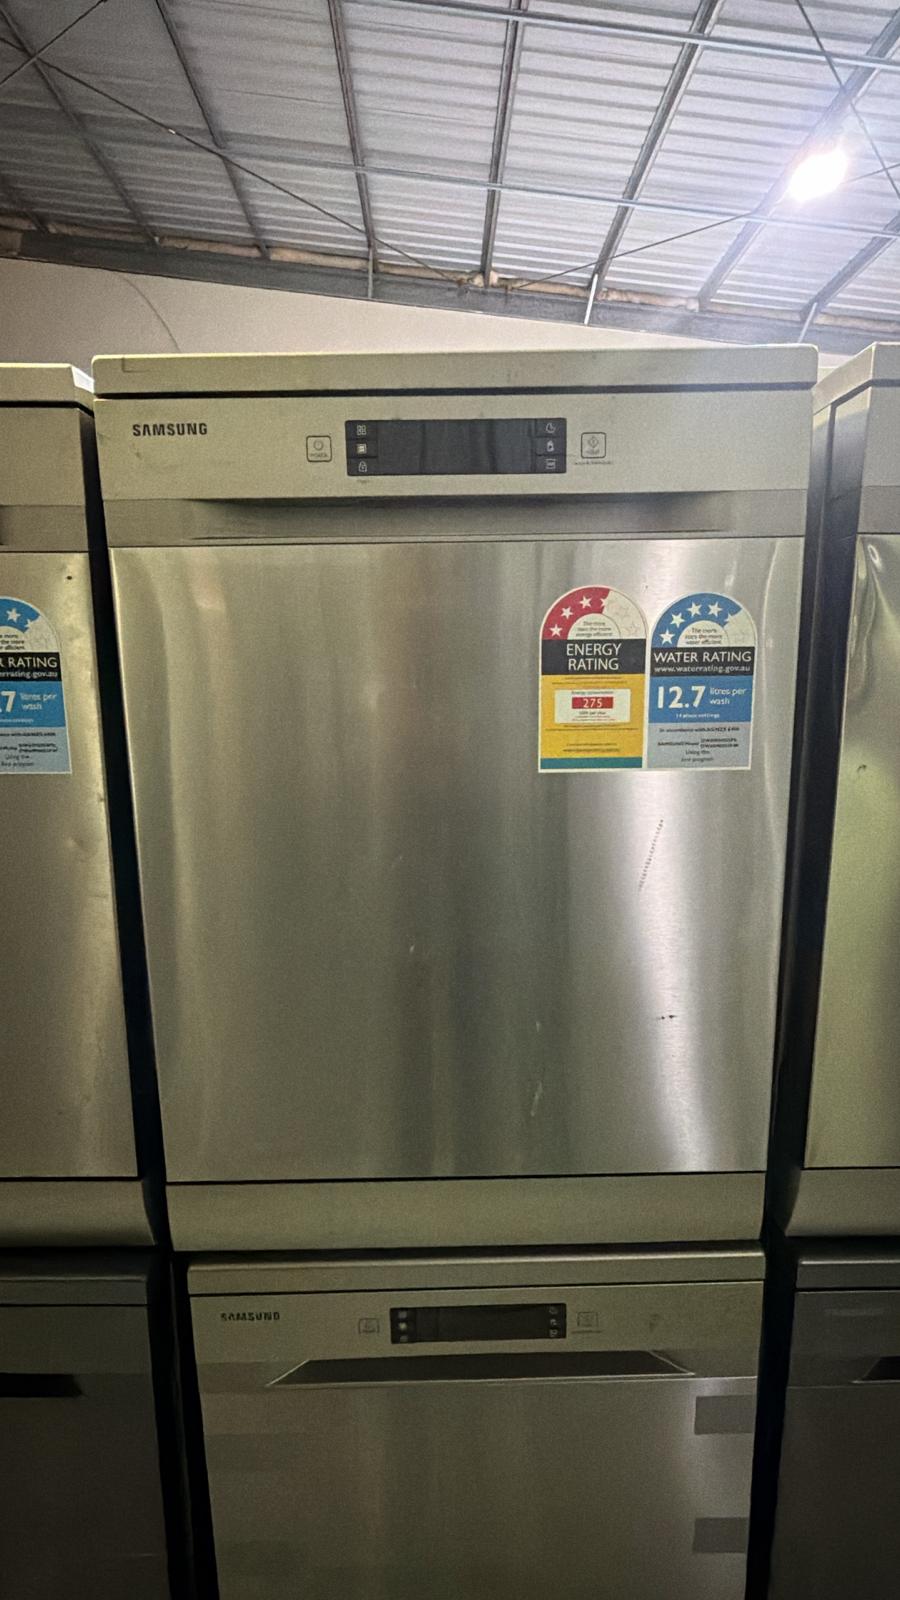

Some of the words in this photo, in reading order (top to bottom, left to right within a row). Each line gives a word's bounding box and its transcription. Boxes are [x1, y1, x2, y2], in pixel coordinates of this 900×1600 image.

[132, 423, 208, 437] SAMSUNG
[566, 643, 622, 656] ENERGY
[8, 657, 58, 668] RATING
[653, 651, 699, 663] WATER
[702, 651, 752, 662] RATING
[568, 658, 619, 671] RATING
[654, 664, 751, 674] www.waterrating.gov.au
[657, 685, 706, 709] 12.7
[709, 687, 730, 695] litres
[731, 688, 747, 697] per
[583, 698, 603, 708] 275
[709, 697, 730, 705] wash
